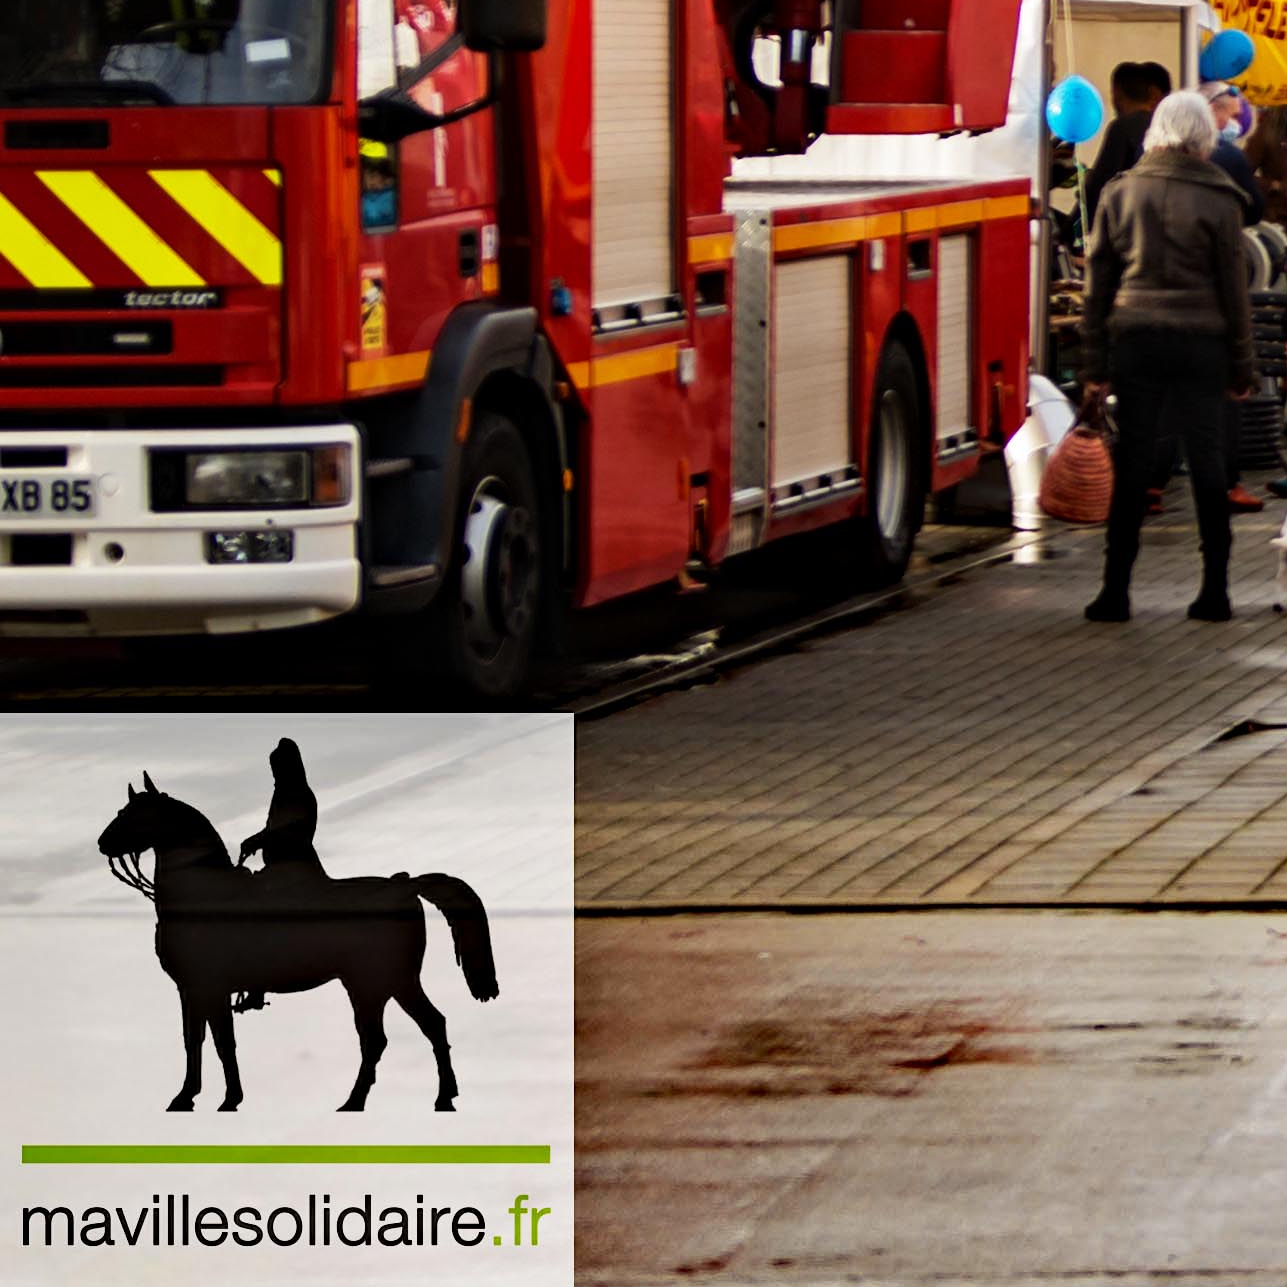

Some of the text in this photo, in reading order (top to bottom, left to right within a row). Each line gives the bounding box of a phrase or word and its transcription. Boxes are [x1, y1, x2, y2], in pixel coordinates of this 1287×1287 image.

[124, 292, 216, 306] tector
[1, 479, 91, 512] XB 85
